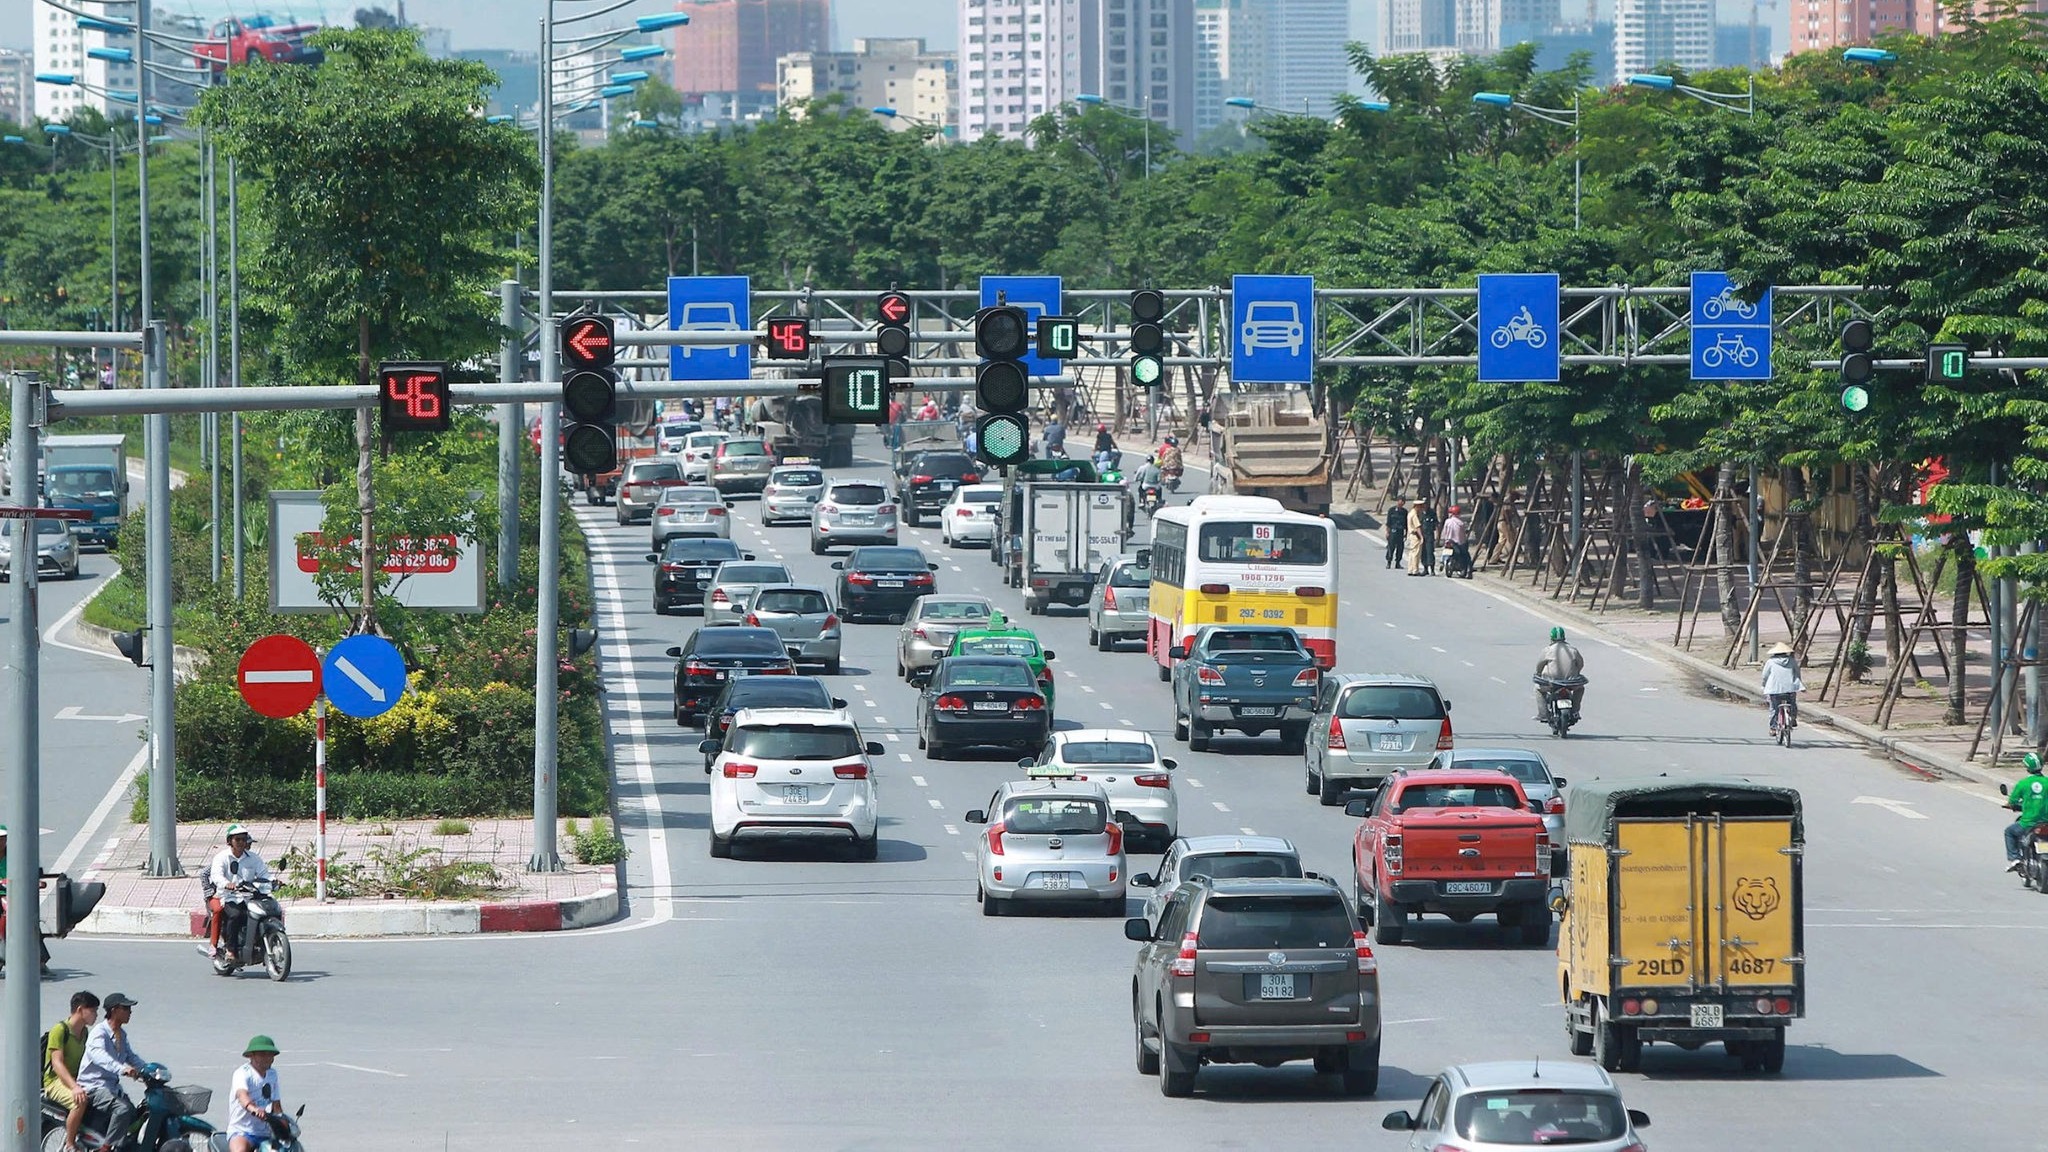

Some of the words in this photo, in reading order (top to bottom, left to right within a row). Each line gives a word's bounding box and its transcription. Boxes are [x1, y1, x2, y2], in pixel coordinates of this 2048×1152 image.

[773, 324, 805, 350] 46
[1052, 324, 1073, 351] 10
[1943, 352, 1963, 377] 10
[388, 376, 439, 417] 46
[848, 369, 880, 410] 10
[1255, 526, 1271, 539] 96
[1263, 609, 1284, 618] 0392
[1637, 959, 1684, 975] 29LD
[1730, 958, 1775, 974] 4687
[1269, 975, 1286, 985] 30A
[1695, 1016, 1720, 1026] 4687
